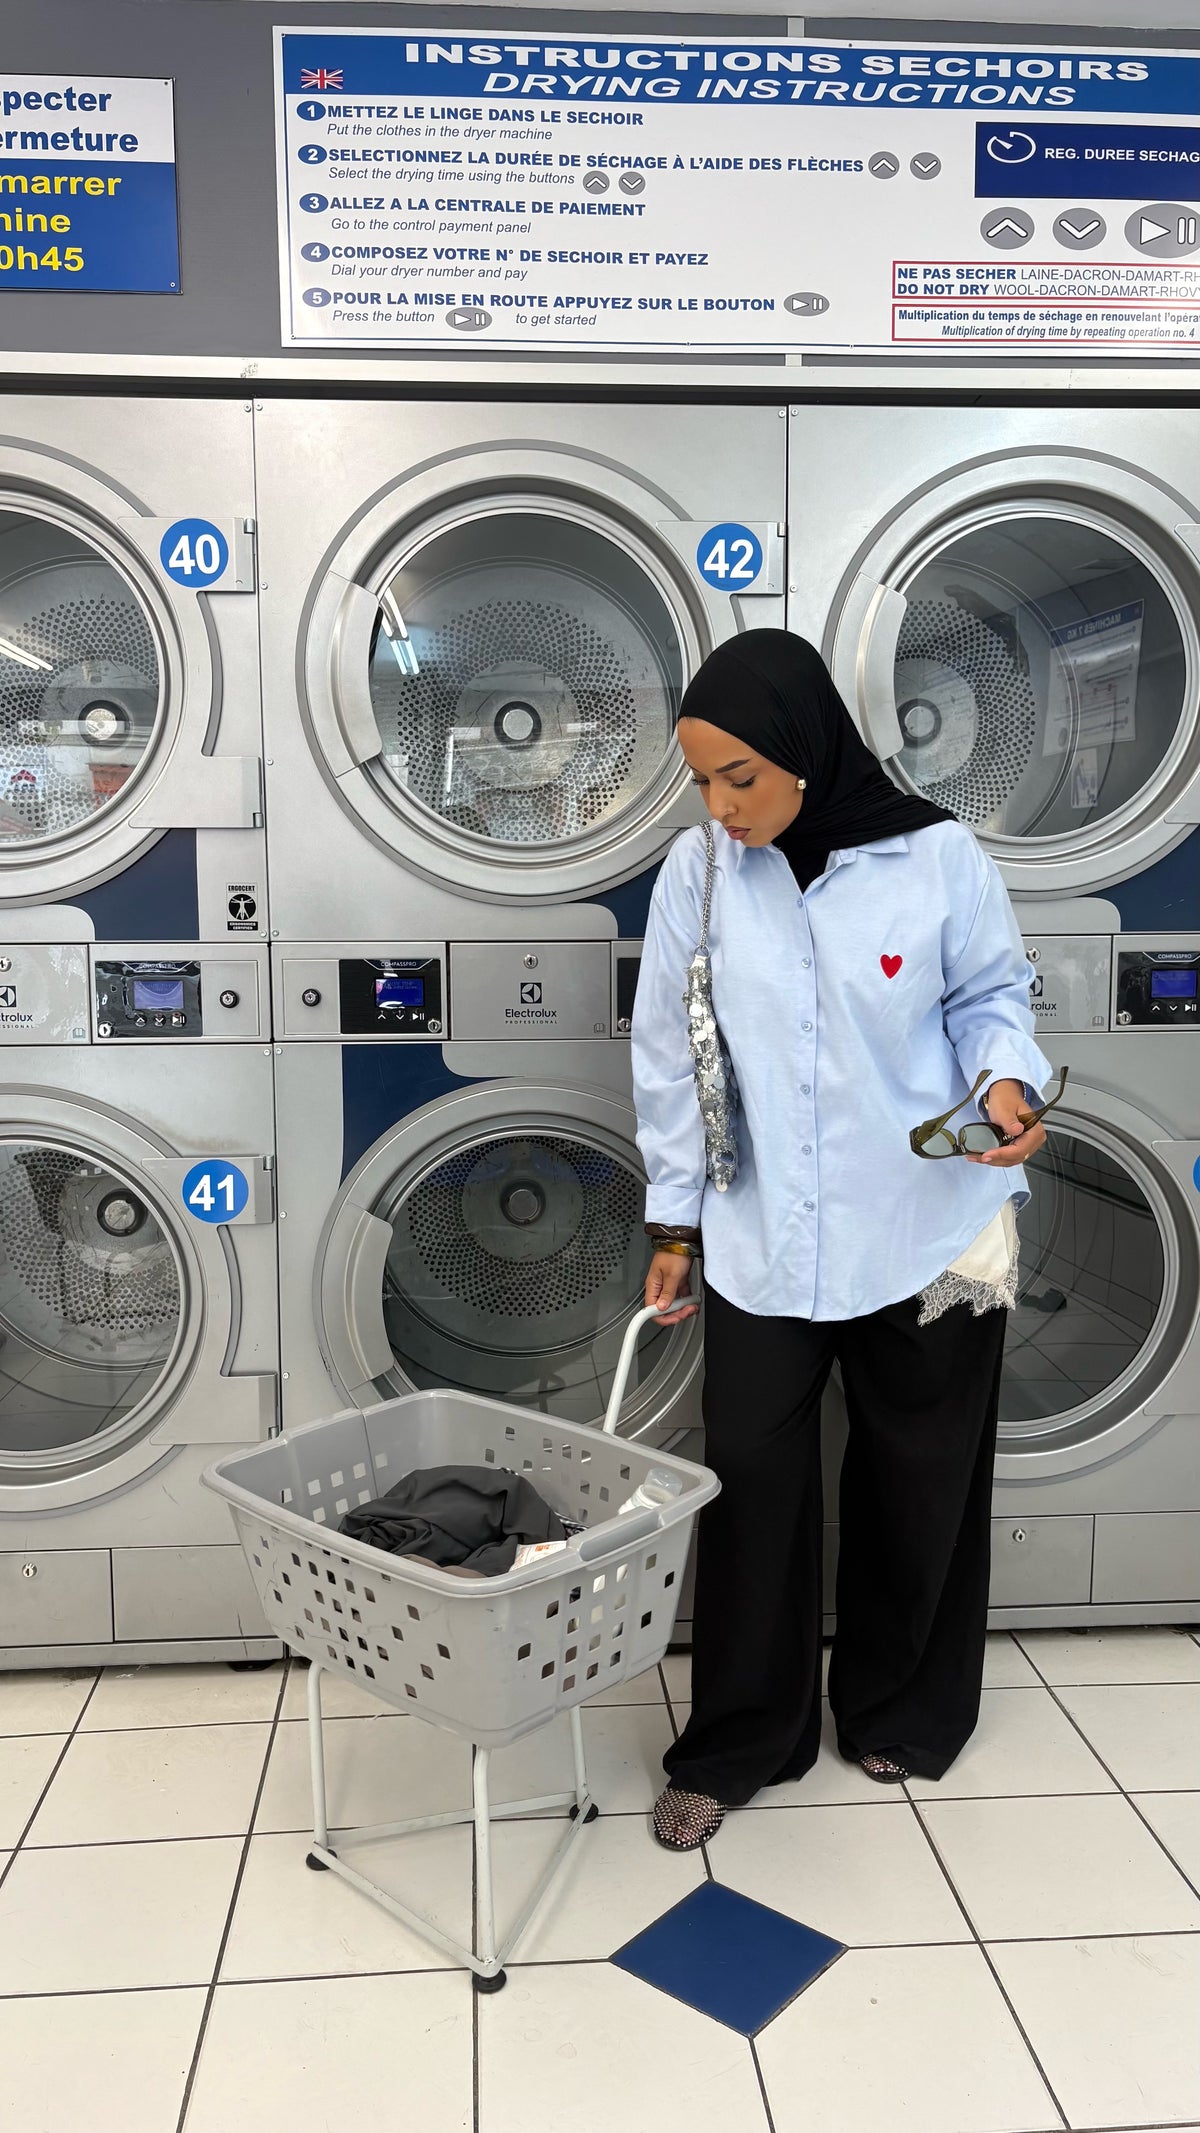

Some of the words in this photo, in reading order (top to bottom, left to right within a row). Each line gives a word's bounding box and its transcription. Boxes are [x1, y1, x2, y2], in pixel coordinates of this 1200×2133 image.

[406, 43, 841, 74] INSTRUCTIONS
[861, 56, 1149, 81] SECHOIRS
[483, 72, 682, 98] DRYING
[696, 78, 1076, 106] INSTRUCTIONS
[0, 86, 112, 116] pecter
[306, 104, 316, 118] 1
[328, 106, 398, 118] METTEZ
[404, 107, 424, 119] LE
[430, 108, 483, 120] LINGE
[488, 108, 535, 122] DANS
[540, 111, 561, 123] LE
[566, 112, 644, 125] SECHOIR
[0, 126, 138, 152] rmeture
[327, 124, 349, 136] Put
[352, 124, 372, 136] the
[376, 124, 421, 137] clothes
[425, 125, 436, 137] in
[439, 126, 459, 138] the
[463, 126, 496, 140] dryer
[500, 128, 553, 140] machine
[308, 148, 318, 161] 2
[329, 149, 462, 164] SELECTIONNEZ
[468, 152, 490, 164] LA
[495, 151, 553, 166] DURÉE
[559, 154, 581, 167] DE
[586, 152, 667, 169] SÉCHAGE
[672, 154, 684, 170] À
[749, 158, 782, 171] DES
[788, 156, 864, 172] FLÈCHES
[1044, 148, 1080, 160] REG.
[1085, 149, 1135, 161] DUREE
[1139, 150, 1200, 162] SECHAG
[329, 167, 368, 180] Select
[372, 168, 392, 179] the
[395, 168, 434, 183] drying
[438, 169, 464, 181] time
[468, 171, 501, 184] using
[506, 171, 526, 182] the
[529, 171, 575, 184] buttons
[310, 197, 320, 209] 3
[330, 197, 385, 210] ALLEZ
[390, 198, 402, 210] A
[408, 199, 430, 210] LA
[435, 199, 526, 213] CENTRALE
[532, 202, 554, 214] DE
[559, 202, 646, 216] PAIEMENT
[331, 218, 350, 230] Go
[353, 219, 365, 230] to
[369, 219, 389, 230] the
[393, 220, 436, 231] control
[439, 221, 493, 235] payment
[496, 222, 531, 235] panel
[310, 246, 321, 258] 4
[331, 247, 428, 260] COMPOSEZ
[433, 248, 490, 261] VOTRE
[496, 249, 514, 261] N°
[520, 250, 542, 262] DE
[547, 251, 624, 265] SECHOIR
[628, 252, 650, 264] ET
[655, 253, 709, 266] PAYEZ
[331, 264, 356, 276] Dial
[359, 267, 388, 279] your
[391, 265, 423, 279] dryer
[426, 266, 475, 278] number
[478, 267, 501, 278] and
[505, 269, 528, 281] pay
[898, 268, 918, 279] NE
[923, 268, 951, 279] PAS
[956, 269, 1016, 280] SECHER
[898, 284, 918, 294] DO
[923, 284, 954, 295] NOT
[960, 284, 989, 295] DRY
[312, 292, 322, 304] 5
[333, 292, 382, 305] POUR
[387, 293, 409, 305] LA
[414, 293, 456, 306] MISE
[461, 294, 484, 306] EN
[490, 295, 548, 307] ROUTE
[553, 296, 633, 310] APPUYEZ
[637, 298, 672, 310] SUR
[678, 298, 698, 311] LE
[704, 298, 775, 312] BOUTON
[333, 310, 368, 322] Press
[372, 310, 393, 322] the
[396, 311, 435, 322] button
[516, 314, 527, 324] to
[531, 314, 551, 327] get
[554, 314, 597, 326] started
[898, 310, 969, 322] Multiplication
[972, 311, 985, 321] du
[988, 311, 1020, 322] temps
[1023, 311, 1036, 321] de
[1039, 311, 1082, 323] séchage
[1101, 312, 1161, 322] renouvelant
[1165, 312, 1200, 324] l'opéra
[942, 326, 1003, 338] Multiplication
[1005, 326, 1016, 336] of
[1017, 326, 1046, 338] drying
[1048, 326, 1067, 336] time
[1071, 326, 1081, 338] by
[1084, 326, 1126, 339] repeating
[1128, 328, 1170, 339] operation
[1189, 328, 1195, 337] 4
[169, 534, 220, 575] 40
[704, 539, 754, 579] 42
[0, 1012, 33, 1022] trolux
[505, 1009, 557, 1017] Electrolux
[189, 1174, 234, 1211] 41
